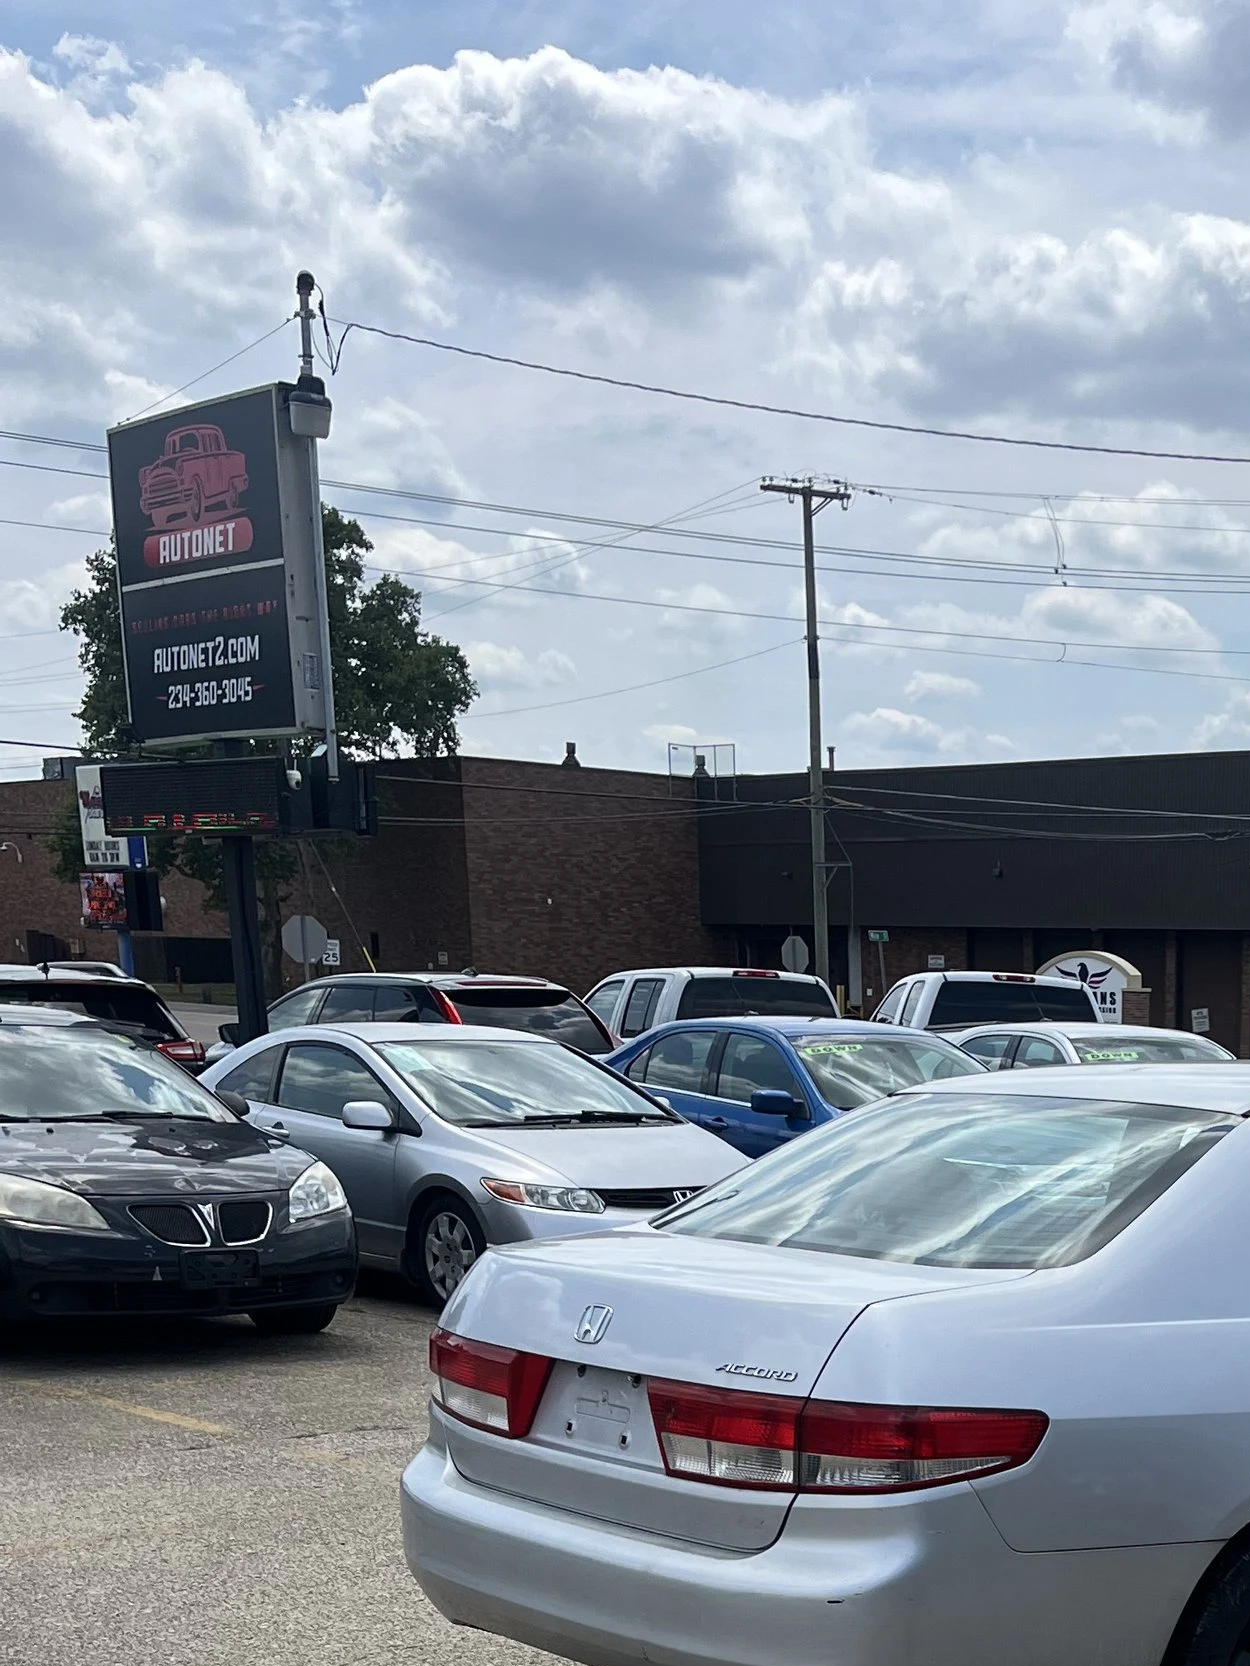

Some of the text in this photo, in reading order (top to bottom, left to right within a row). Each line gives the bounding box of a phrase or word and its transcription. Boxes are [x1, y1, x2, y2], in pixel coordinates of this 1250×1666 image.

[159, 522, 236, 564] AUTONET
[153, 634, 260, 674] AUTONET2.COM
[167, 676, 253, 709] 234-360-3045
[324, 952, 339, 963] 25
[715, 1363, 799, 1382] ACCORD
